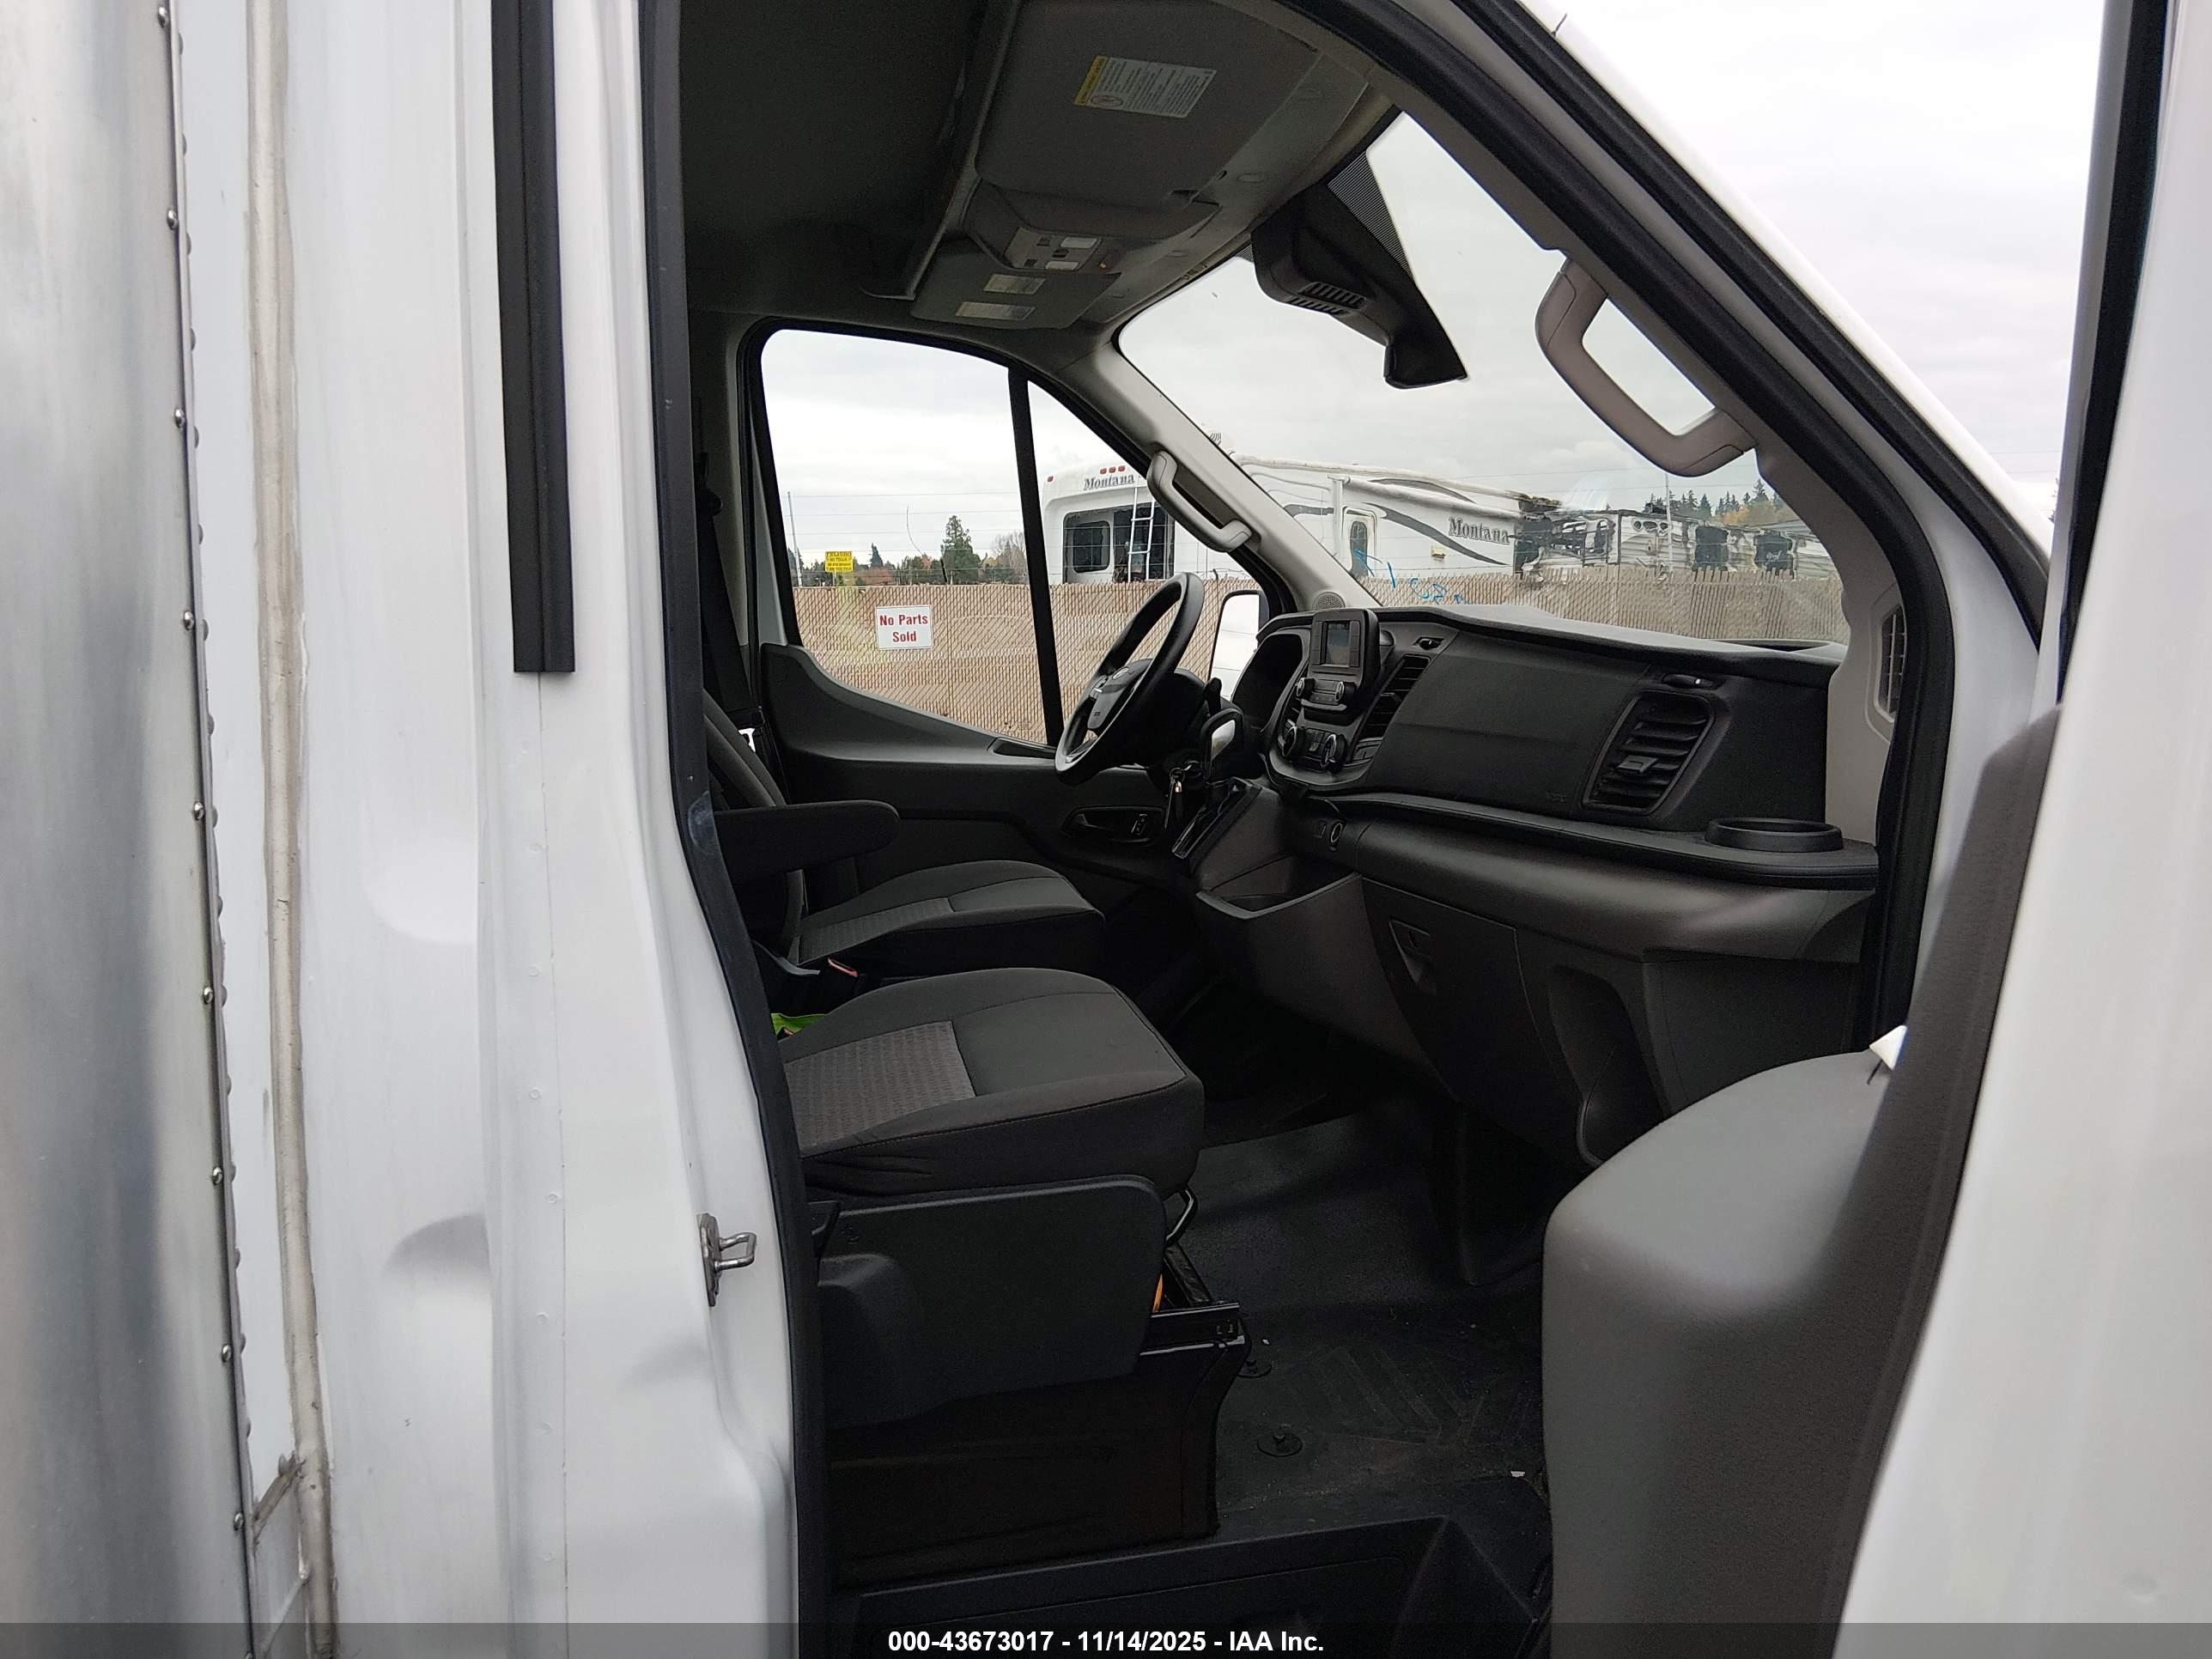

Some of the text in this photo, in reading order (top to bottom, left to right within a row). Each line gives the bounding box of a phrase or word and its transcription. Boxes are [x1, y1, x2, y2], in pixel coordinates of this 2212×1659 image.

[1083, 474, 1134, 490] Montana
[1448, 517, 1510, 544] Montana
[879, 613, 928, 626] No Parts
[893, 631, 916, 642] Sold
